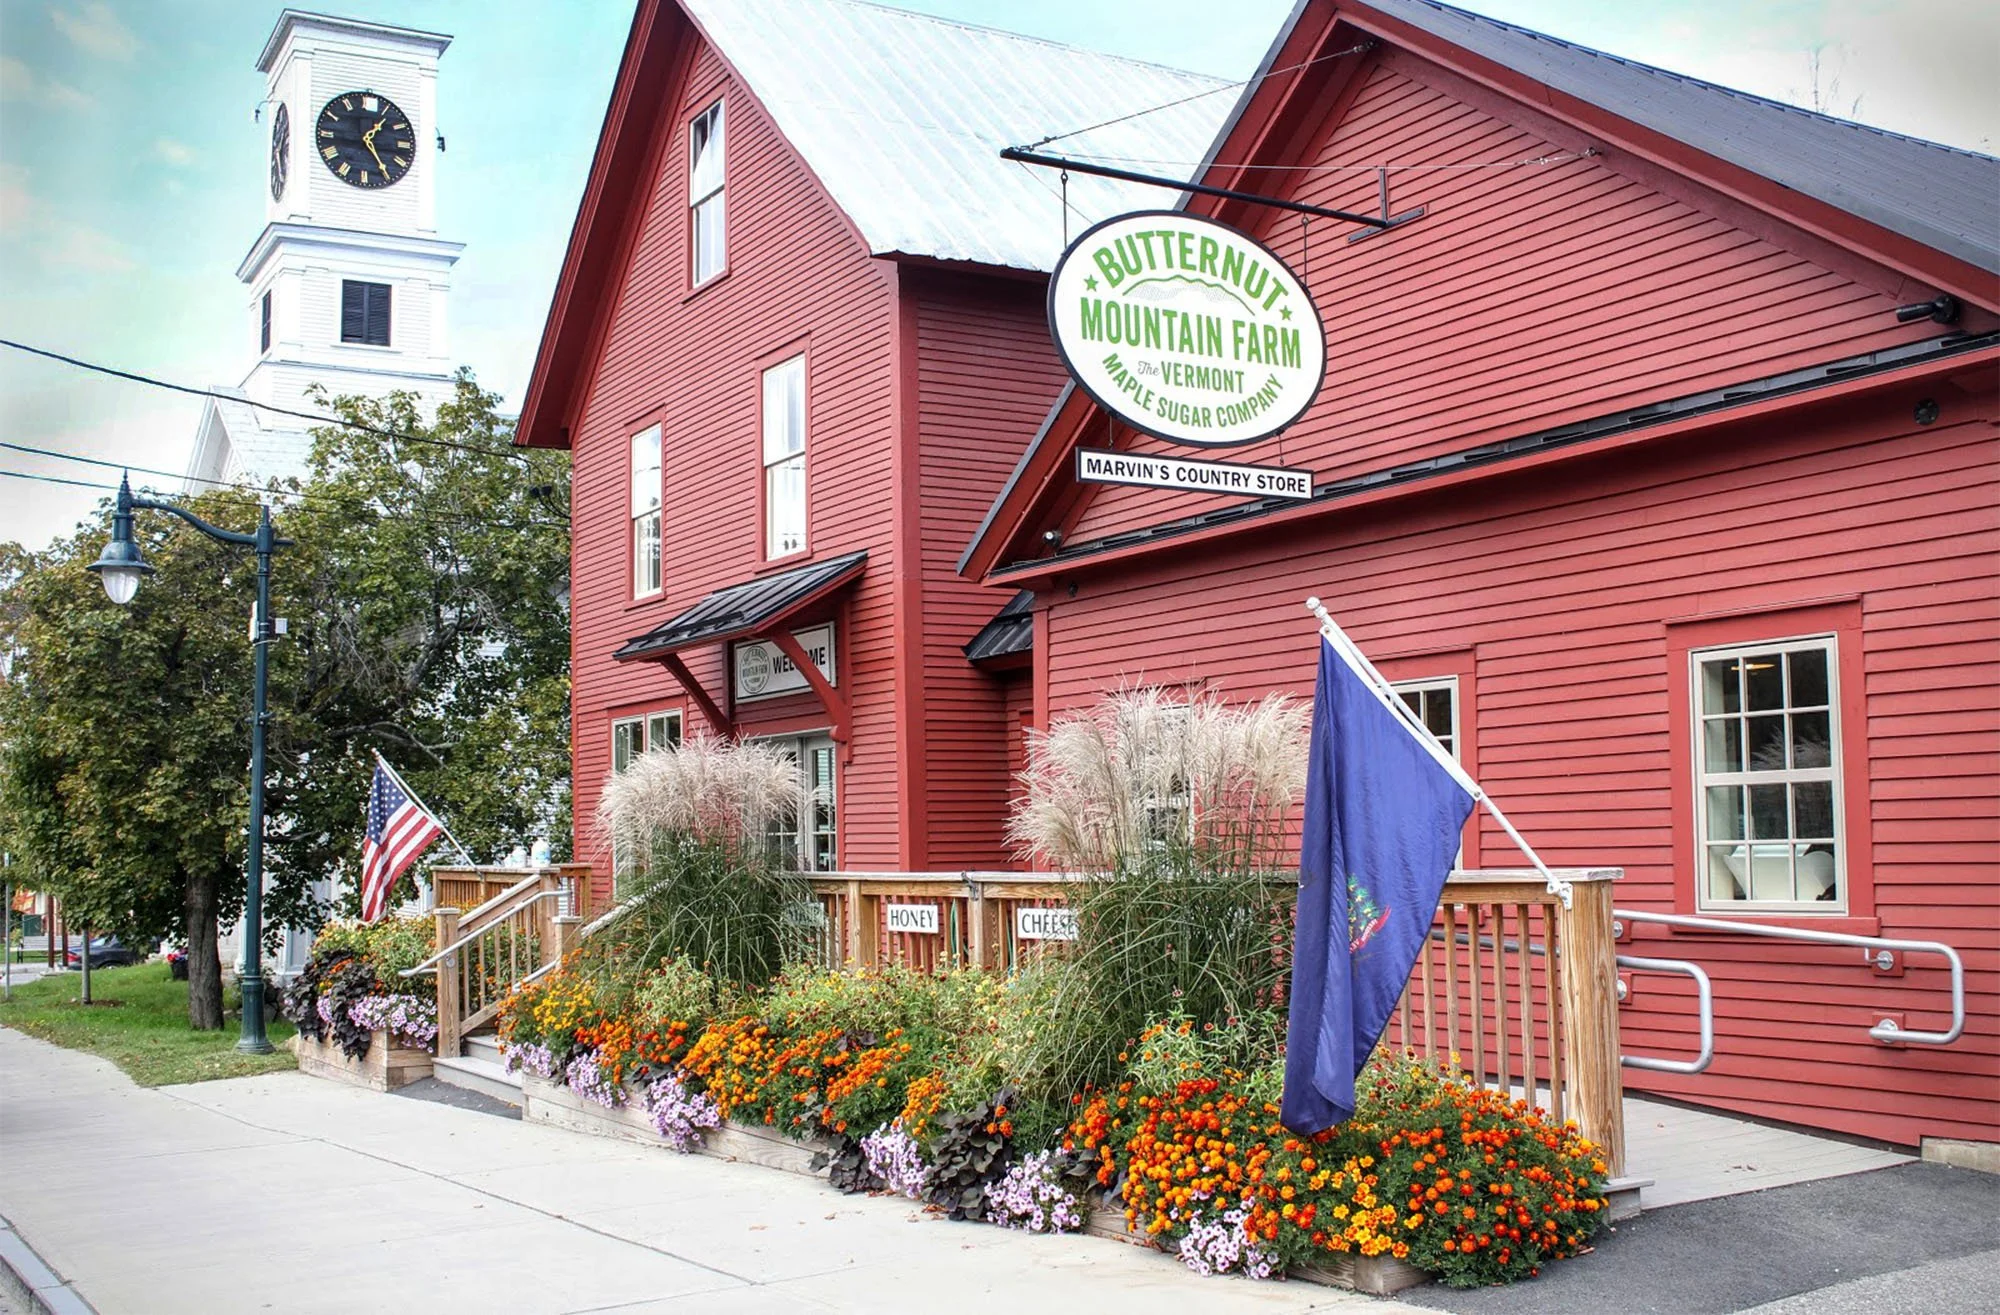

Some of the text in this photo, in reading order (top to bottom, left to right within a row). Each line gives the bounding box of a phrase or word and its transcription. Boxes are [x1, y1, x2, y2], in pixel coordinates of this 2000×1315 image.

[1092, 230, 1289, 311] BUTTERNUT
[1080, 297, 1302, 369] MOUNTAIN FARM
[1102, 352, 1284, 428] MAPLE SUGAR COMPANY
[1137, 360, 1245, 394] The VERMONT
[1086, 458, 1306, 493] MARVIN'S COUNTRY STORE
[772, 646, 826, 674] WELME
[890, 908, 935, 929] HONEY
